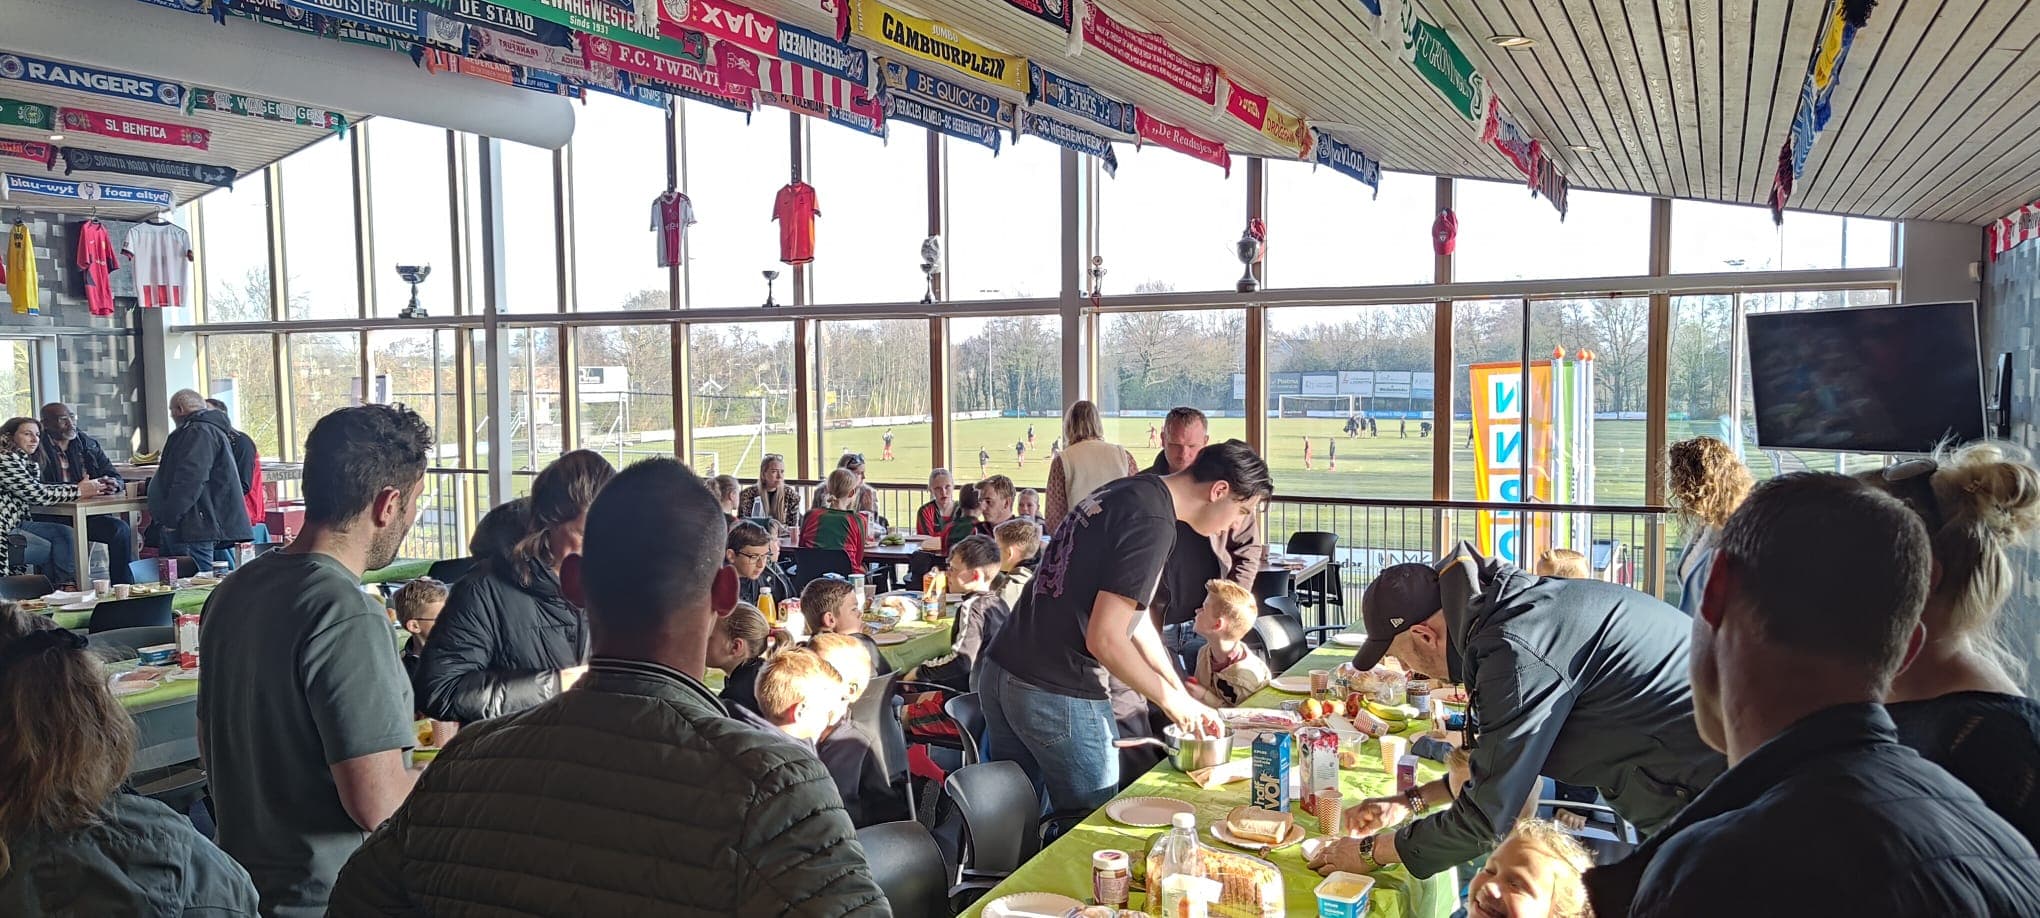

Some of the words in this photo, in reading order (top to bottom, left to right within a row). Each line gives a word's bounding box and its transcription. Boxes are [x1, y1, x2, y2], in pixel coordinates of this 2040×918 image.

[314, 0, 418, 27] TSTERTILLE
[486, 1, 534, 32] STAND
[569, 15, 591, 29] Sinds
[700, 1, 774, 43] AJAX
[619, 45, 650, 68] F.C.
[778, 28, 844, 70] HEERENVEEN
[882, 12, 1006, 80] CAMBUURPLEIN
[27, 61, 154, 98] RANGERS
[918, 73, 934, 95] BE
[936, 81, 991, 114] QUICK-D
[105, 118, 120, 133] SL
[122, 121, 167, 139] BENFICA
[1050, 122, 1103, 151] HEERENVEEN
[10, 176, 75, 194] blau-wyt
[105, 187, 133, 198] foar
[136, 191, 170, 204] altyd!
